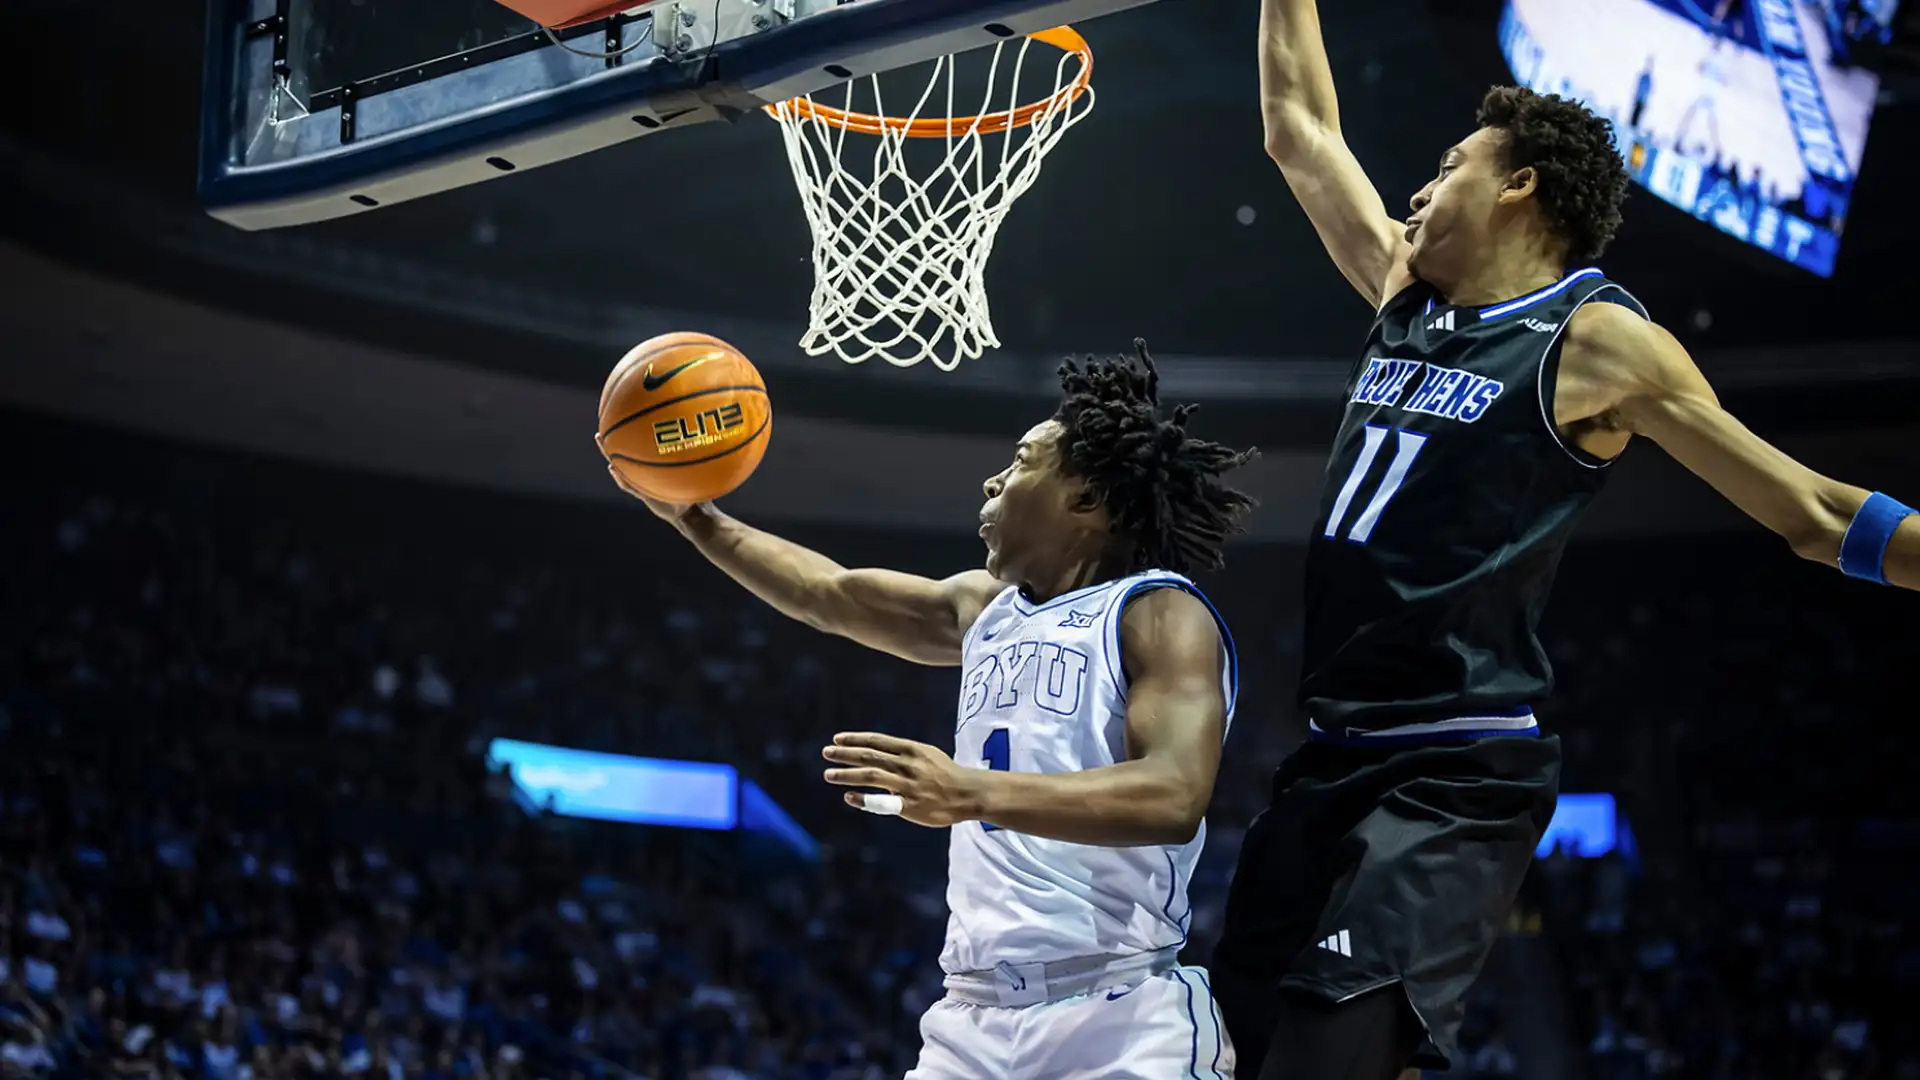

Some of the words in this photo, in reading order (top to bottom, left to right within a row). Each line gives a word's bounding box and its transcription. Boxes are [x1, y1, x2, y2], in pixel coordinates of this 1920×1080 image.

[653, 402, 744, 446] ELITE
[1402, 362, 1504, 423] HENS
[1324, 422, 1431, 545] 11
[955, 641, 1088, 734] BYU
